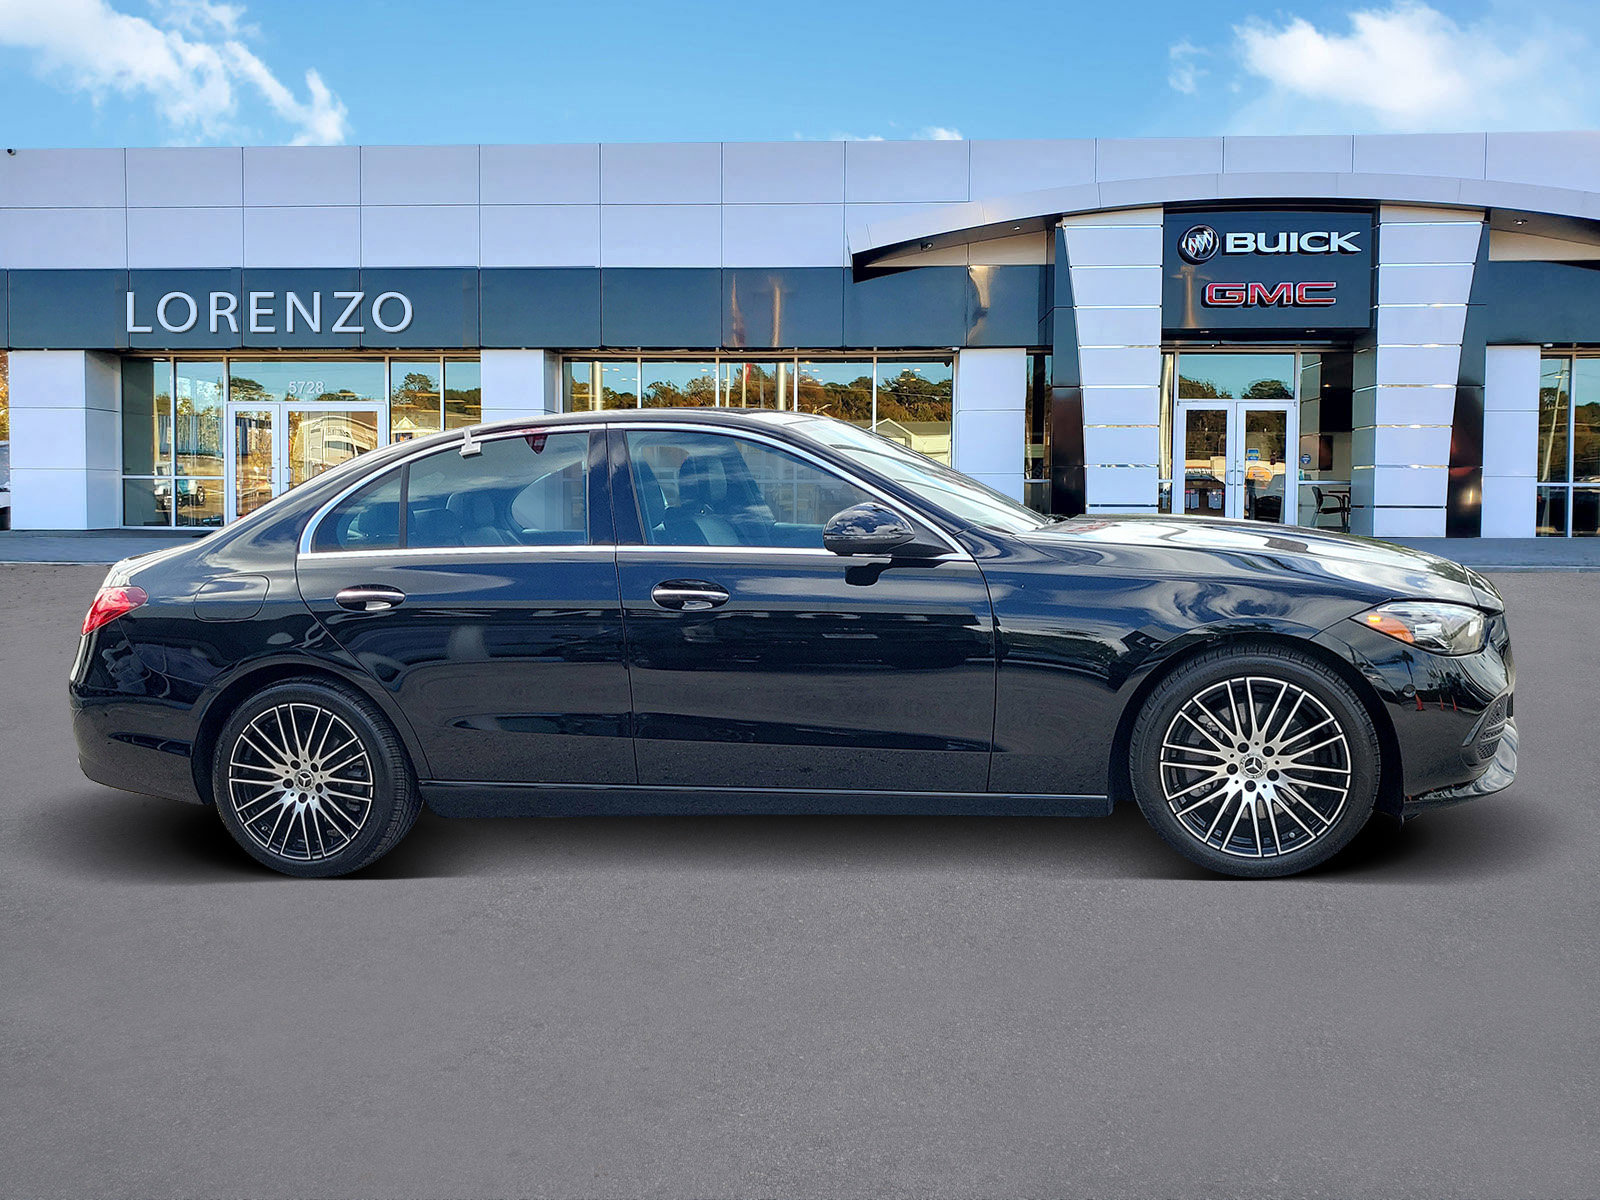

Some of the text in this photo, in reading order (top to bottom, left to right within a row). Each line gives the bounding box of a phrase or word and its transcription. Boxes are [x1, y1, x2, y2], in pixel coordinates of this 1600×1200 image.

[1225, 231, 1362, 253] BUICK
[1205, 281, 1337, 305] GMC
[126, 291, 413, 333] LORENZO
[288, 381, 325, 394] 5728
